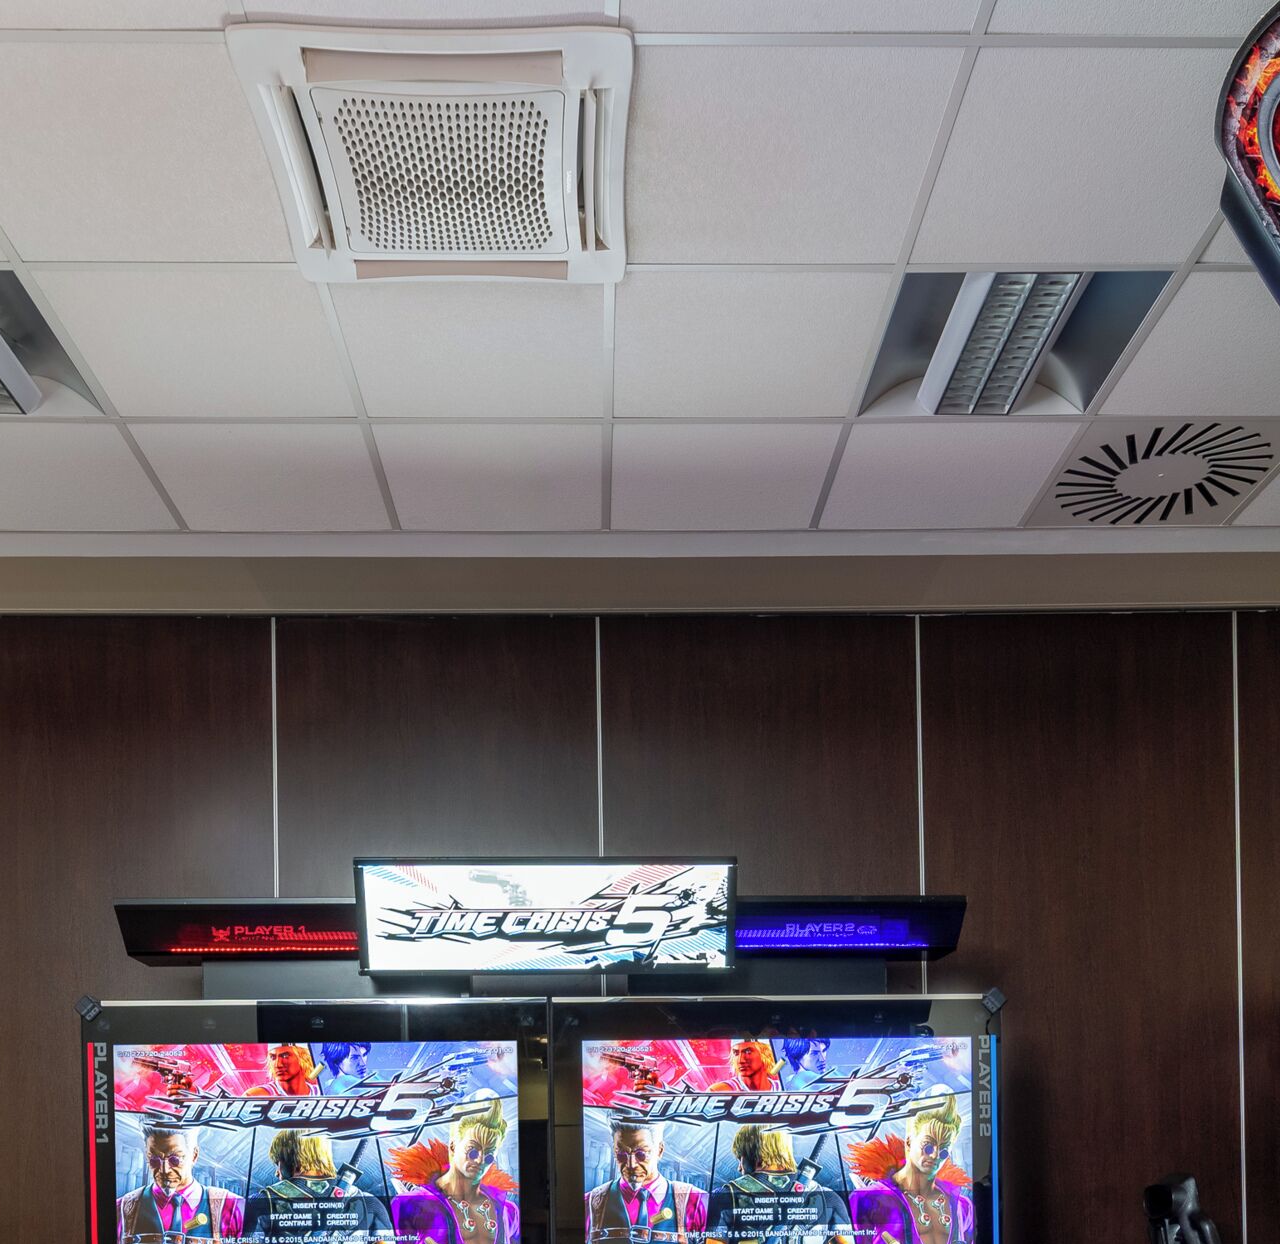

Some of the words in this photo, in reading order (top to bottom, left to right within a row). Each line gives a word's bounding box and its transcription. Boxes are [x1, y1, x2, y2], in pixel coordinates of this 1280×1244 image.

[234, 925, 294, 936] PLAYER
[298, 925, 306, 935] 1
[414, 911, 503, 937] TIME
[503, 911, 618, 935] CRISIS
[605, 893, 678, 949] 5
[785, 922, 844, 933] PLAYER
[844, 922, 856, 932] 2
[94, 1042, 109, 1129] PLAYER
[648, 1093, 729, 1118] TIME
[730, 1093, 834, 1118] CRISIS
[829, 1075, 892, 1126] 5
[978, 1034, 991, 1119] PLAYER
[183, 1098, 264, 1123] TIME
[266, 1098, 373, 1123] CRISIS
[370, 1081, 436, 1131] 5
[979, 1123, 991, 1137] 2
[96, 1133, 109, 1143] 1
